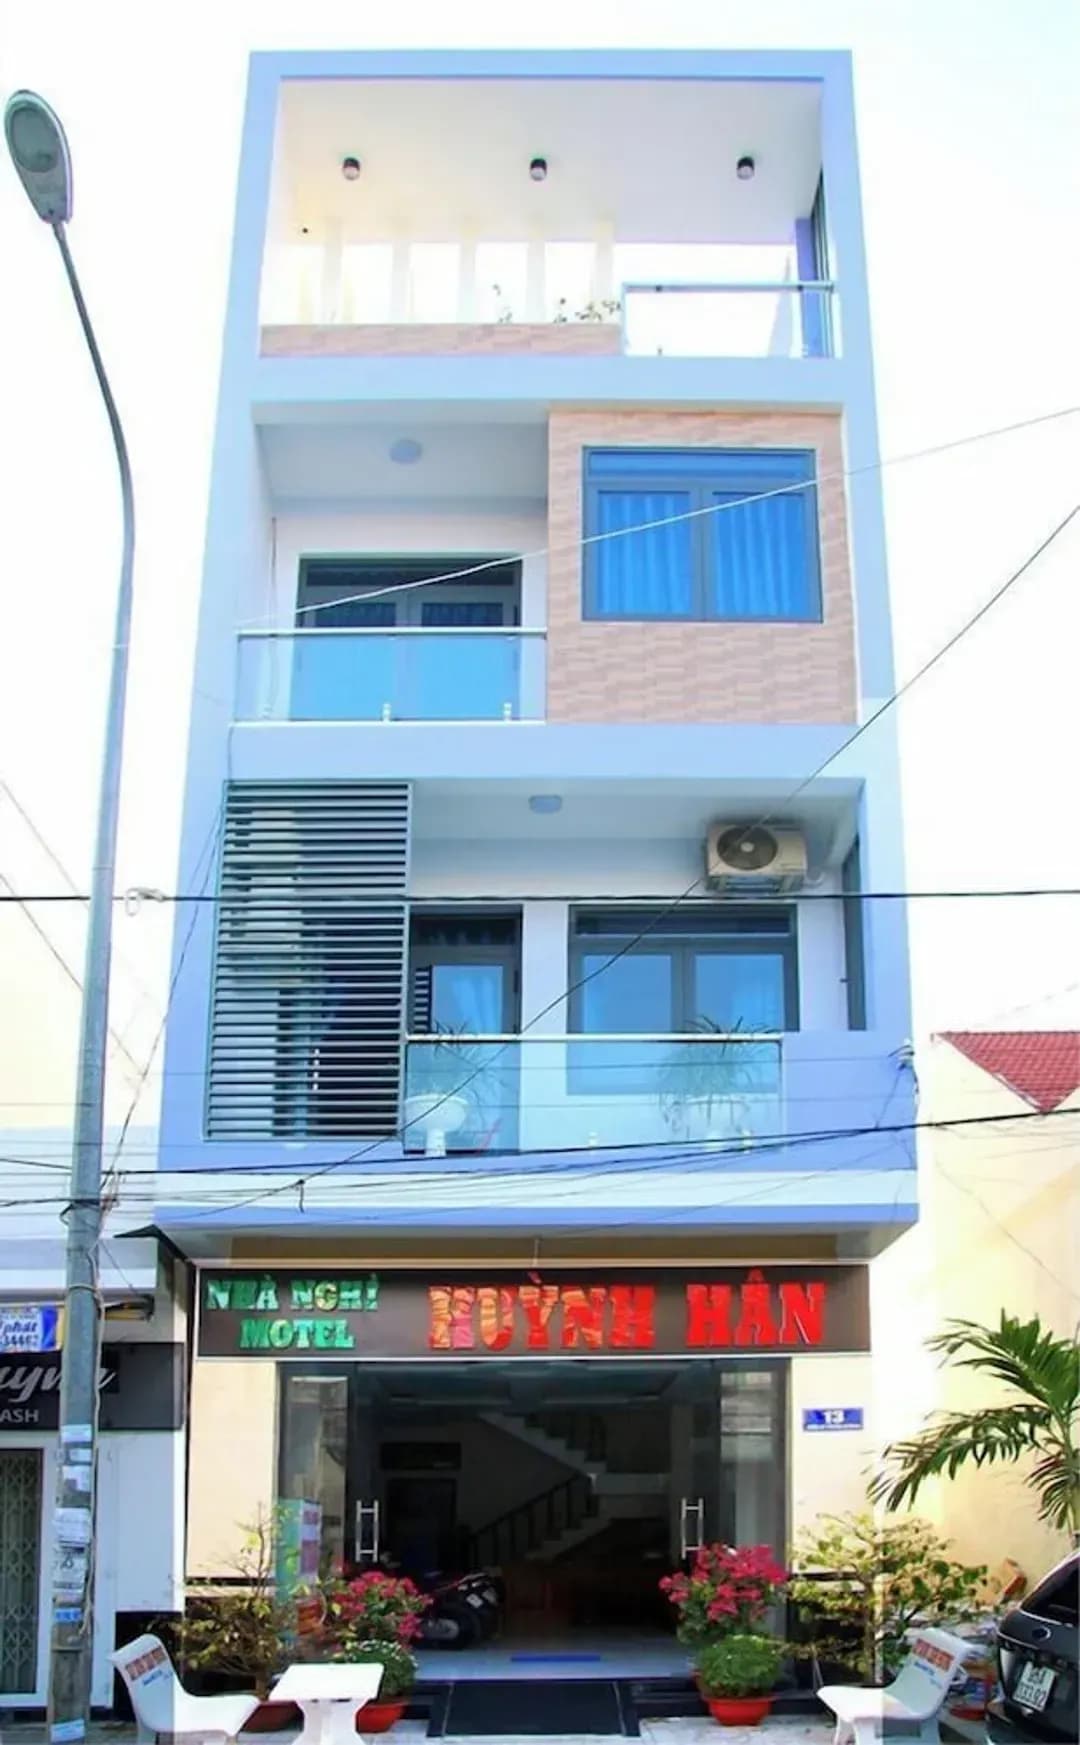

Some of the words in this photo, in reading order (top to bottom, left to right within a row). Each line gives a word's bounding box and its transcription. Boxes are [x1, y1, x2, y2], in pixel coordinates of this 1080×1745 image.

[207, 1275, 279, 1311] NHÀ
[428, 1271, 655, 1350] HUỲNH
[686, 1268, 827, 1347] HÂN
[240, 1319, 354, 1348] MOTEL
[823, 1410, 846, 1425] 13
